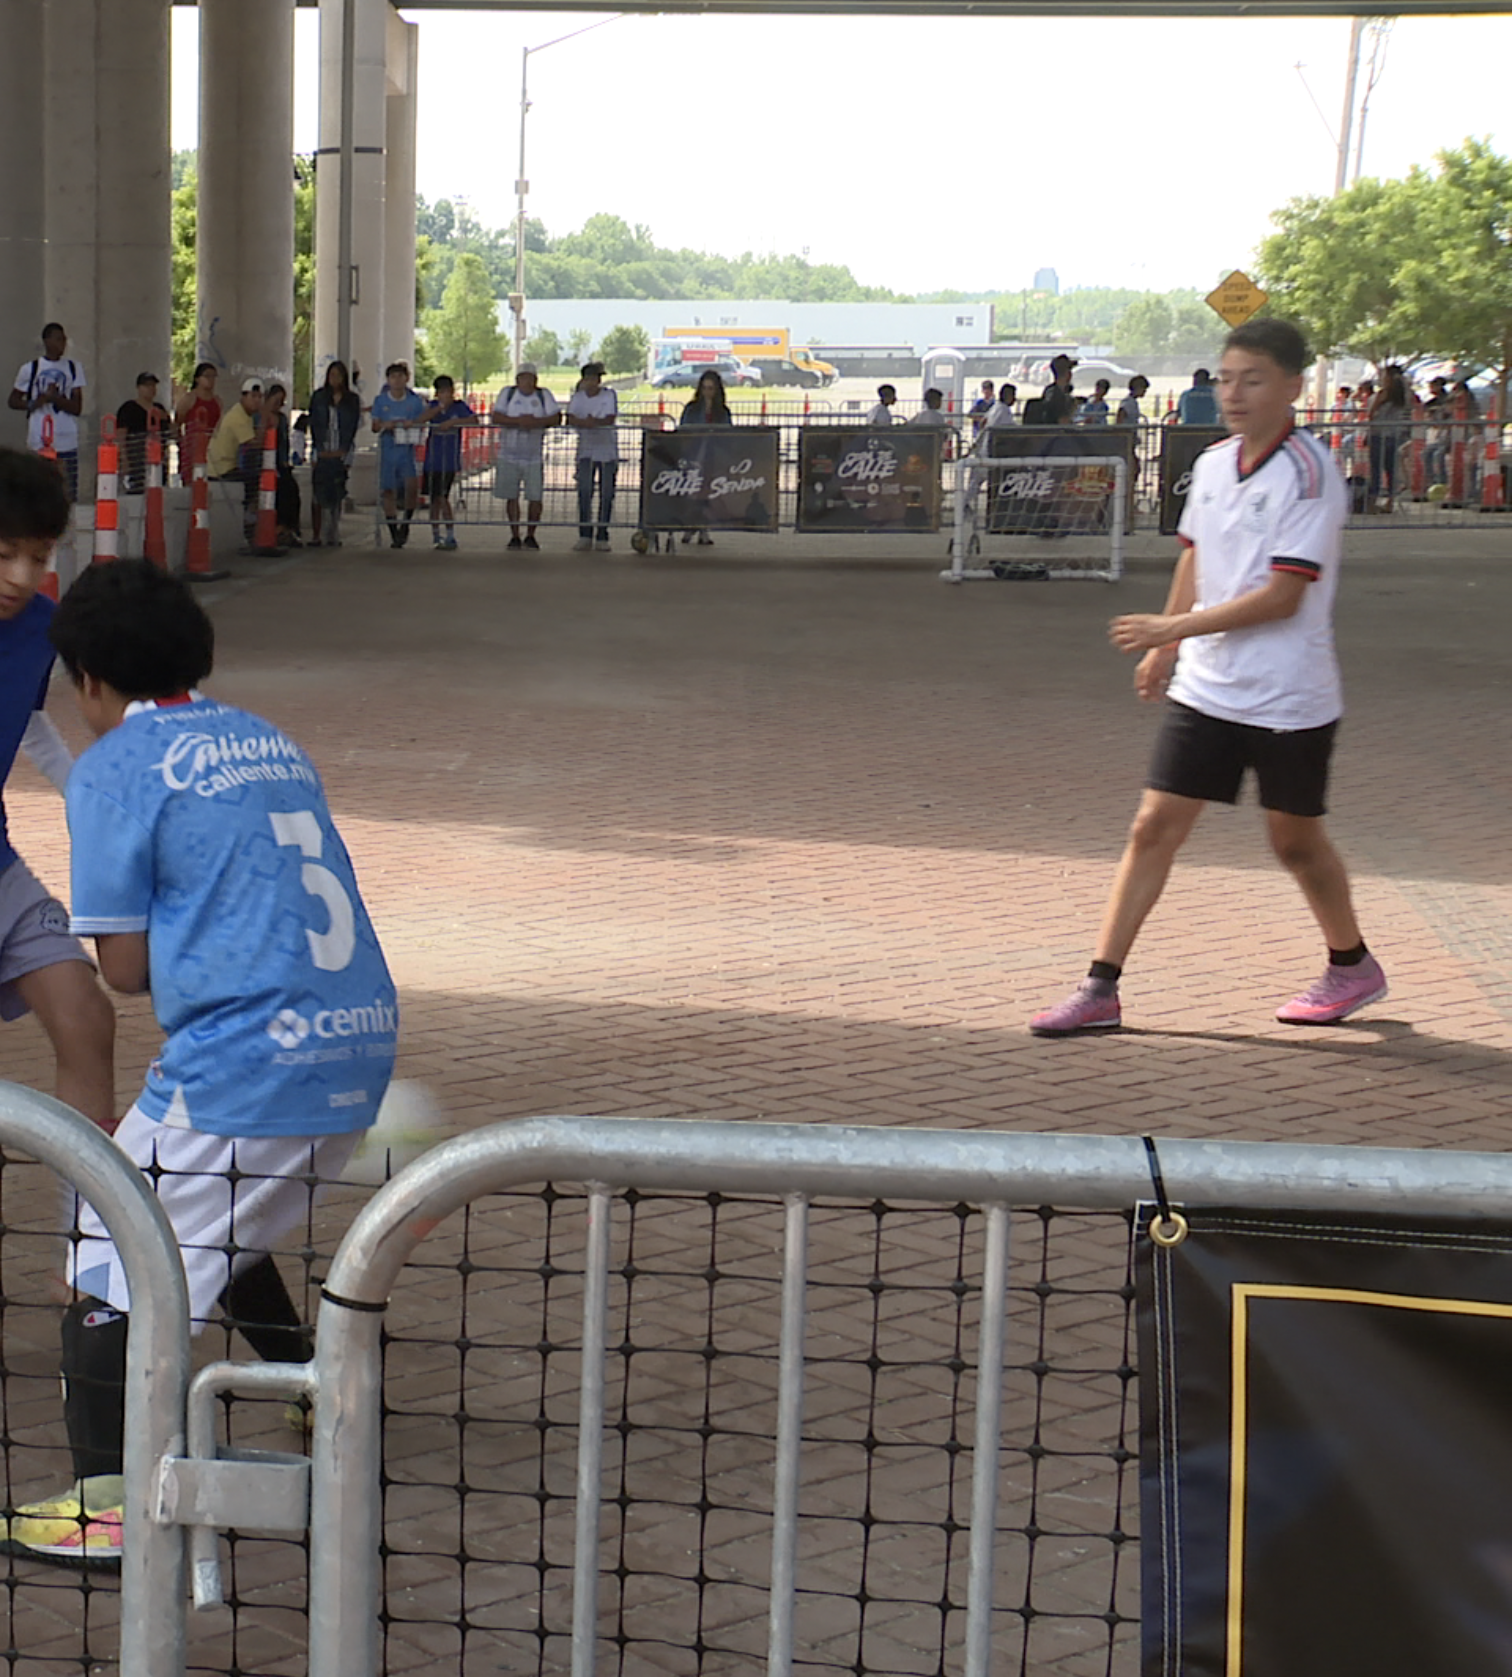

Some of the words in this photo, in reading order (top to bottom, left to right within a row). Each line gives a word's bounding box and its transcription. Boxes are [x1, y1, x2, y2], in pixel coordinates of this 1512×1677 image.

[837, 459, 899, 480] CALLE
[650, 477, 704, 497] CALLE
[998, 479, 1056, 499] CALLE
[149, 731, 303, 790] Caliente
[268, 810, 356, 972] 3
[314, 998, 397, 1039] cemix
